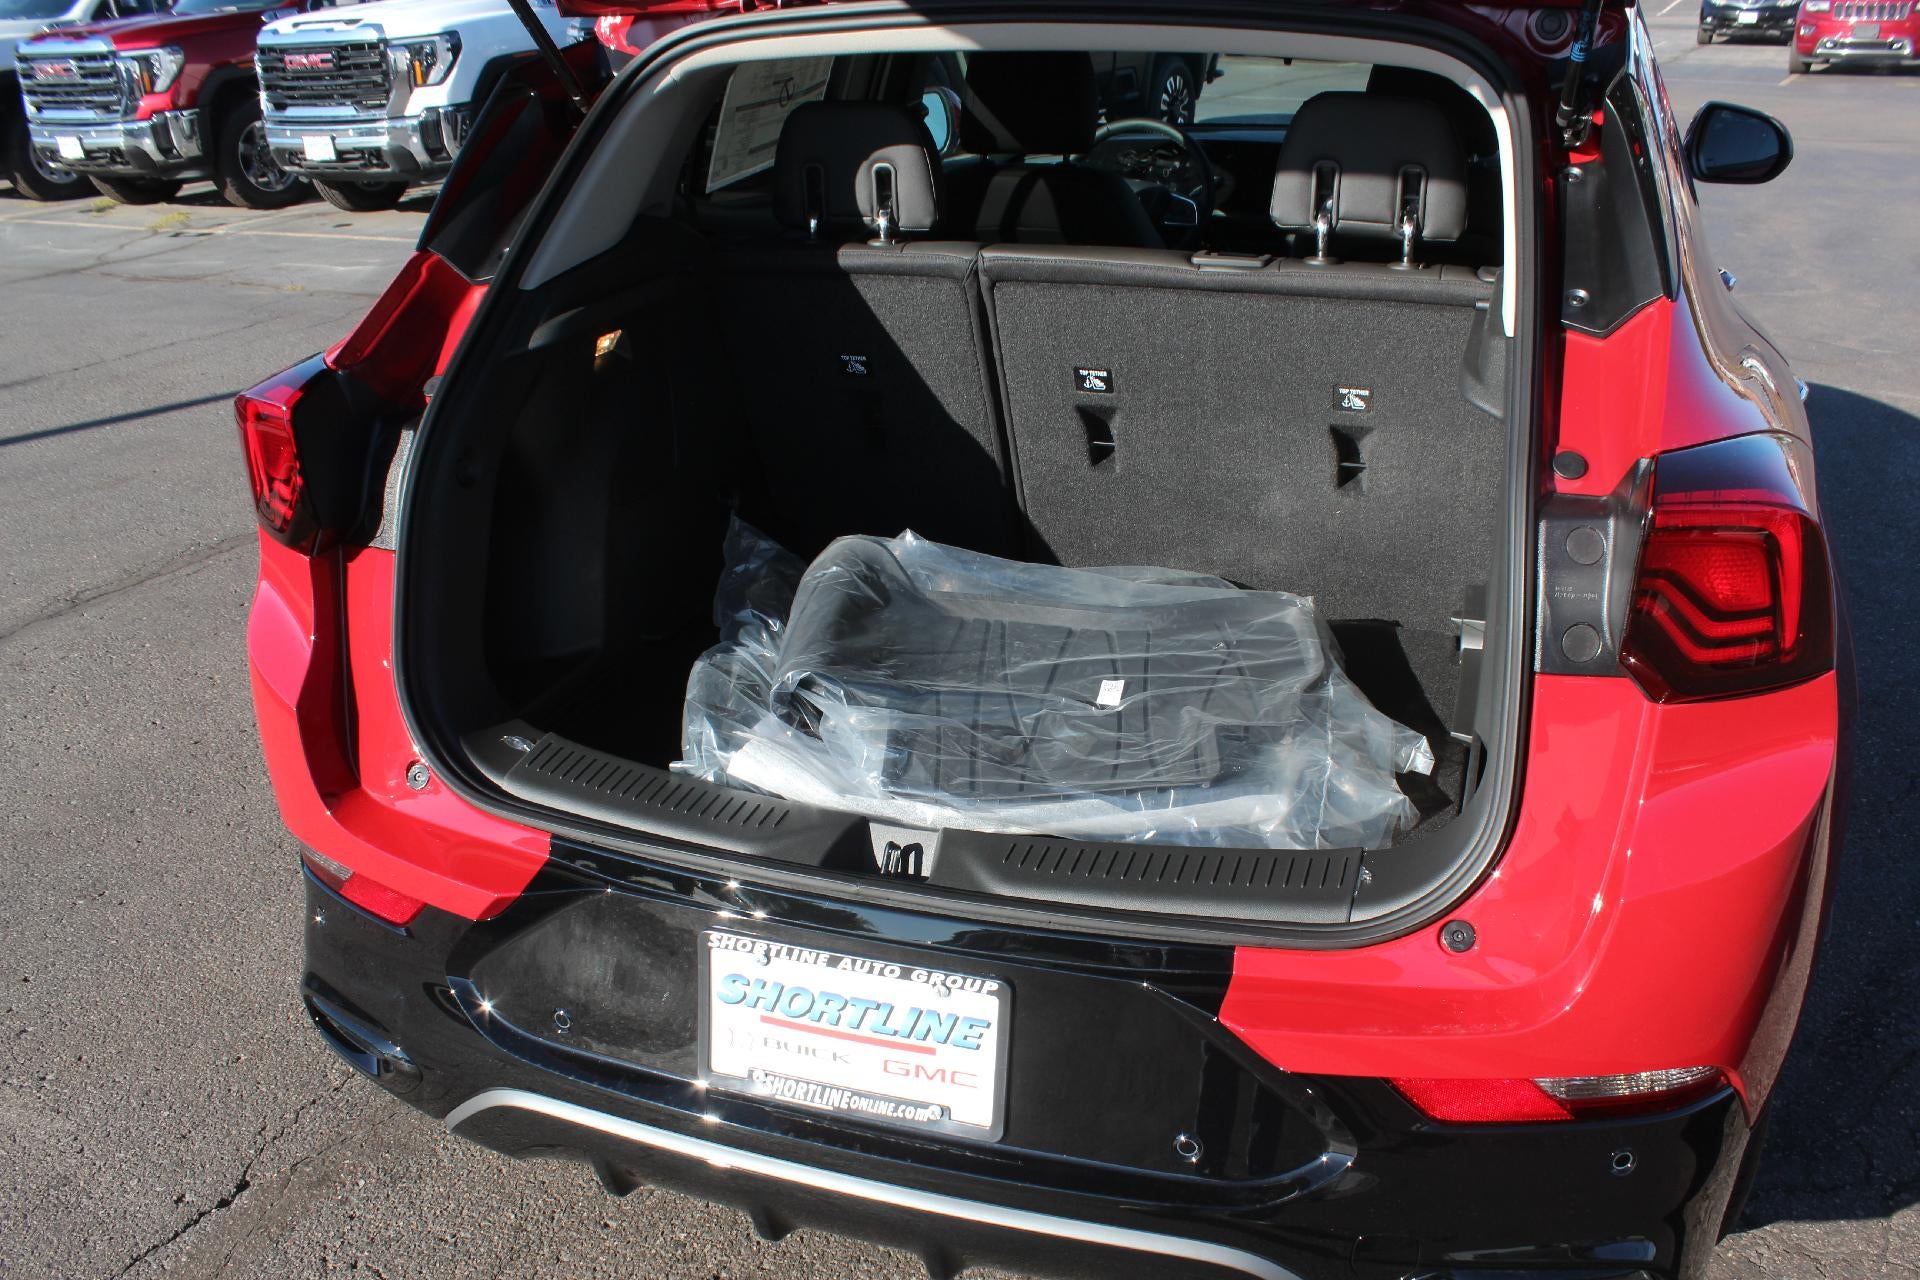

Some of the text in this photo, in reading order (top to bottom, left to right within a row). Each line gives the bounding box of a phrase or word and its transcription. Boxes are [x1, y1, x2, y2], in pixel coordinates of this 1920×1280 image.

[284, 53, 333, 69] GMC
[707, 933, 999, 995] SHORTLINE AUTO GROUP
[716, 973, 992, 1050] SHORTLINE
[763, 1037, 850, 1064] BUICK
[882, 1059, 978, 1089] GMC
